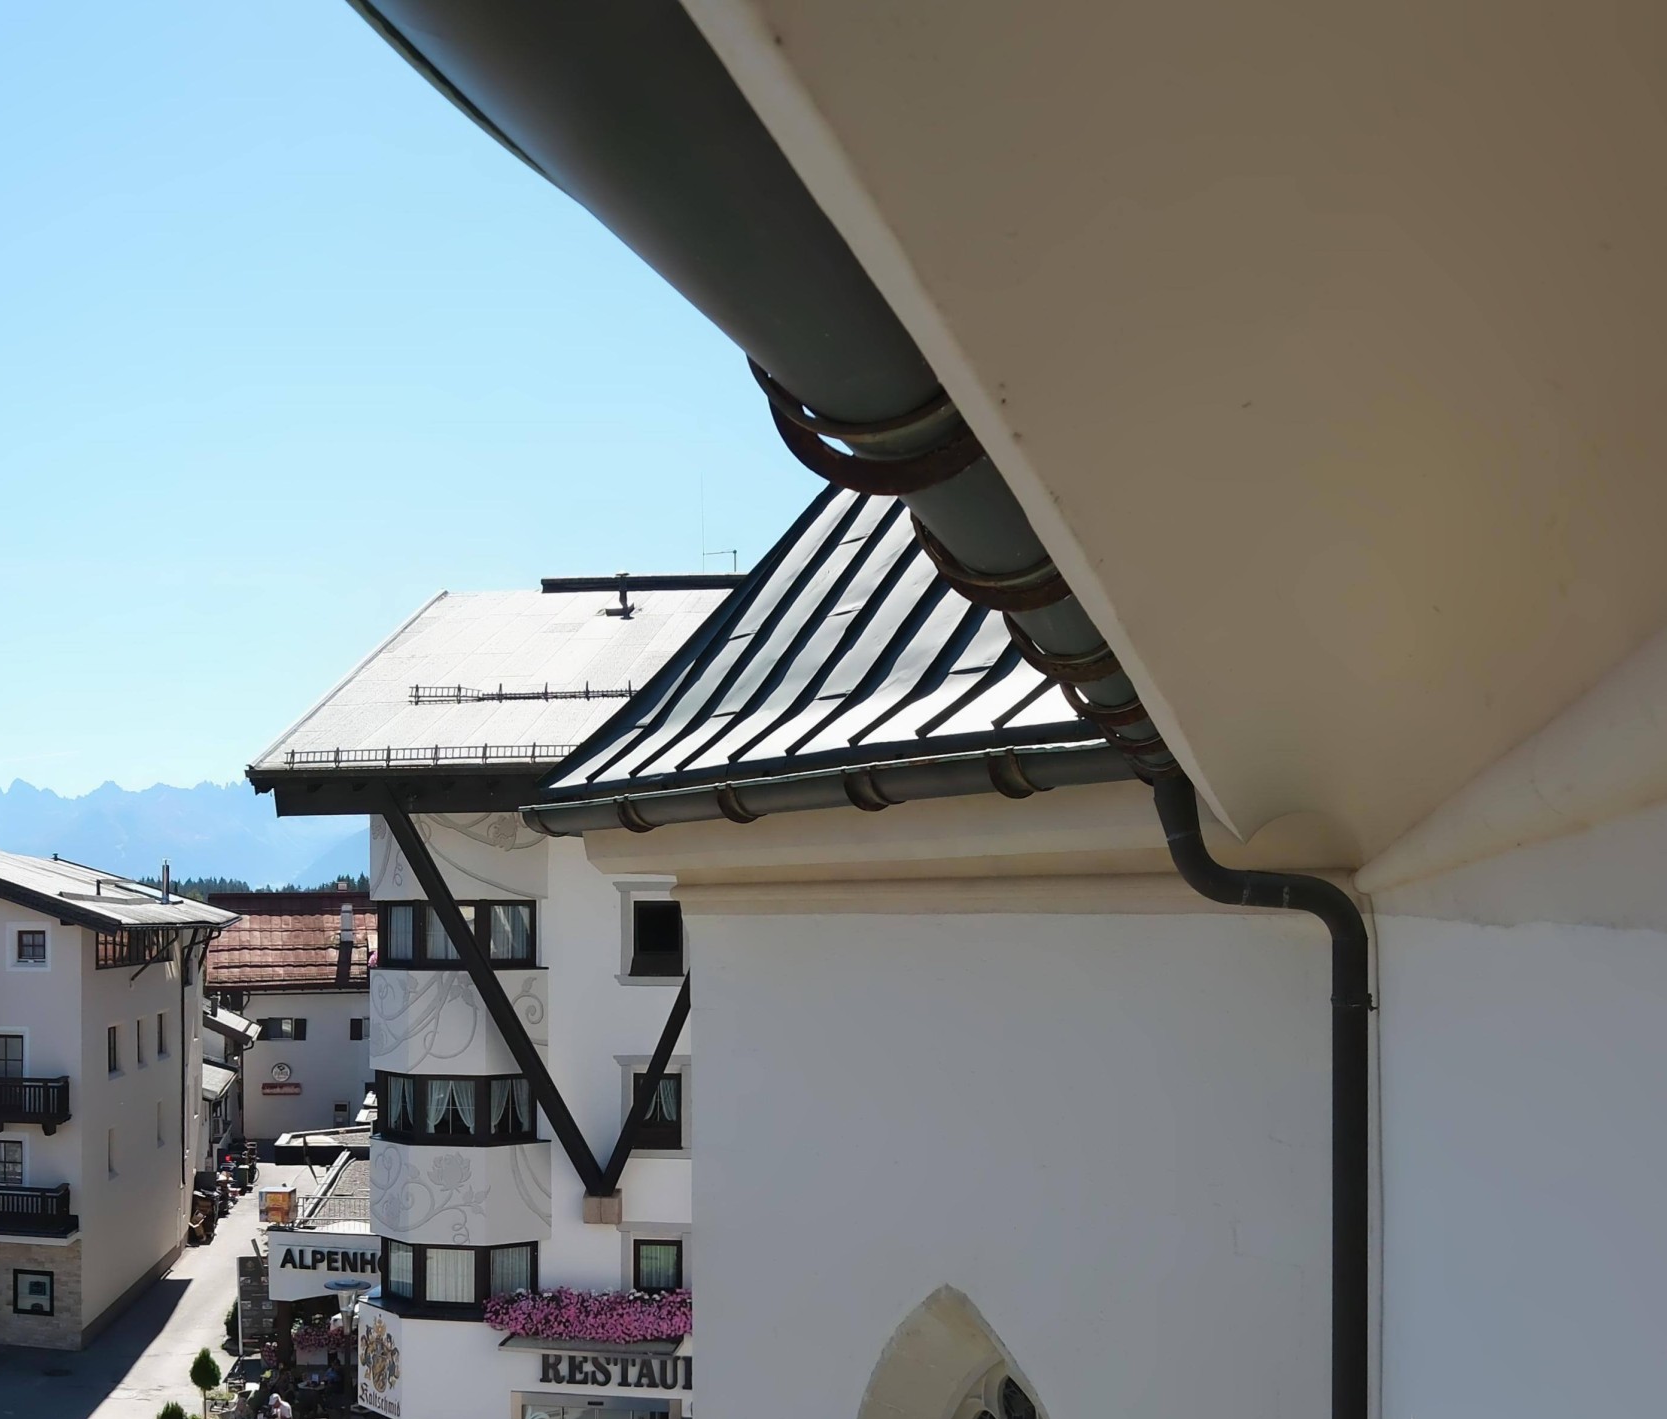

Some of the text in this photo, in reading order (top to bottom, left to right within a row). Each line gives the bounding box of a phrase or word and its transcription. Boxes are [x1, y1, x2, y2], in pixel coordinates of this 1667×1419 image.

[279, 1247, 383, 1274] ALPENH
[540, 1354, 693, 1389] RESTAU
[358, 1382, 401, 1418] Kaltschmid
